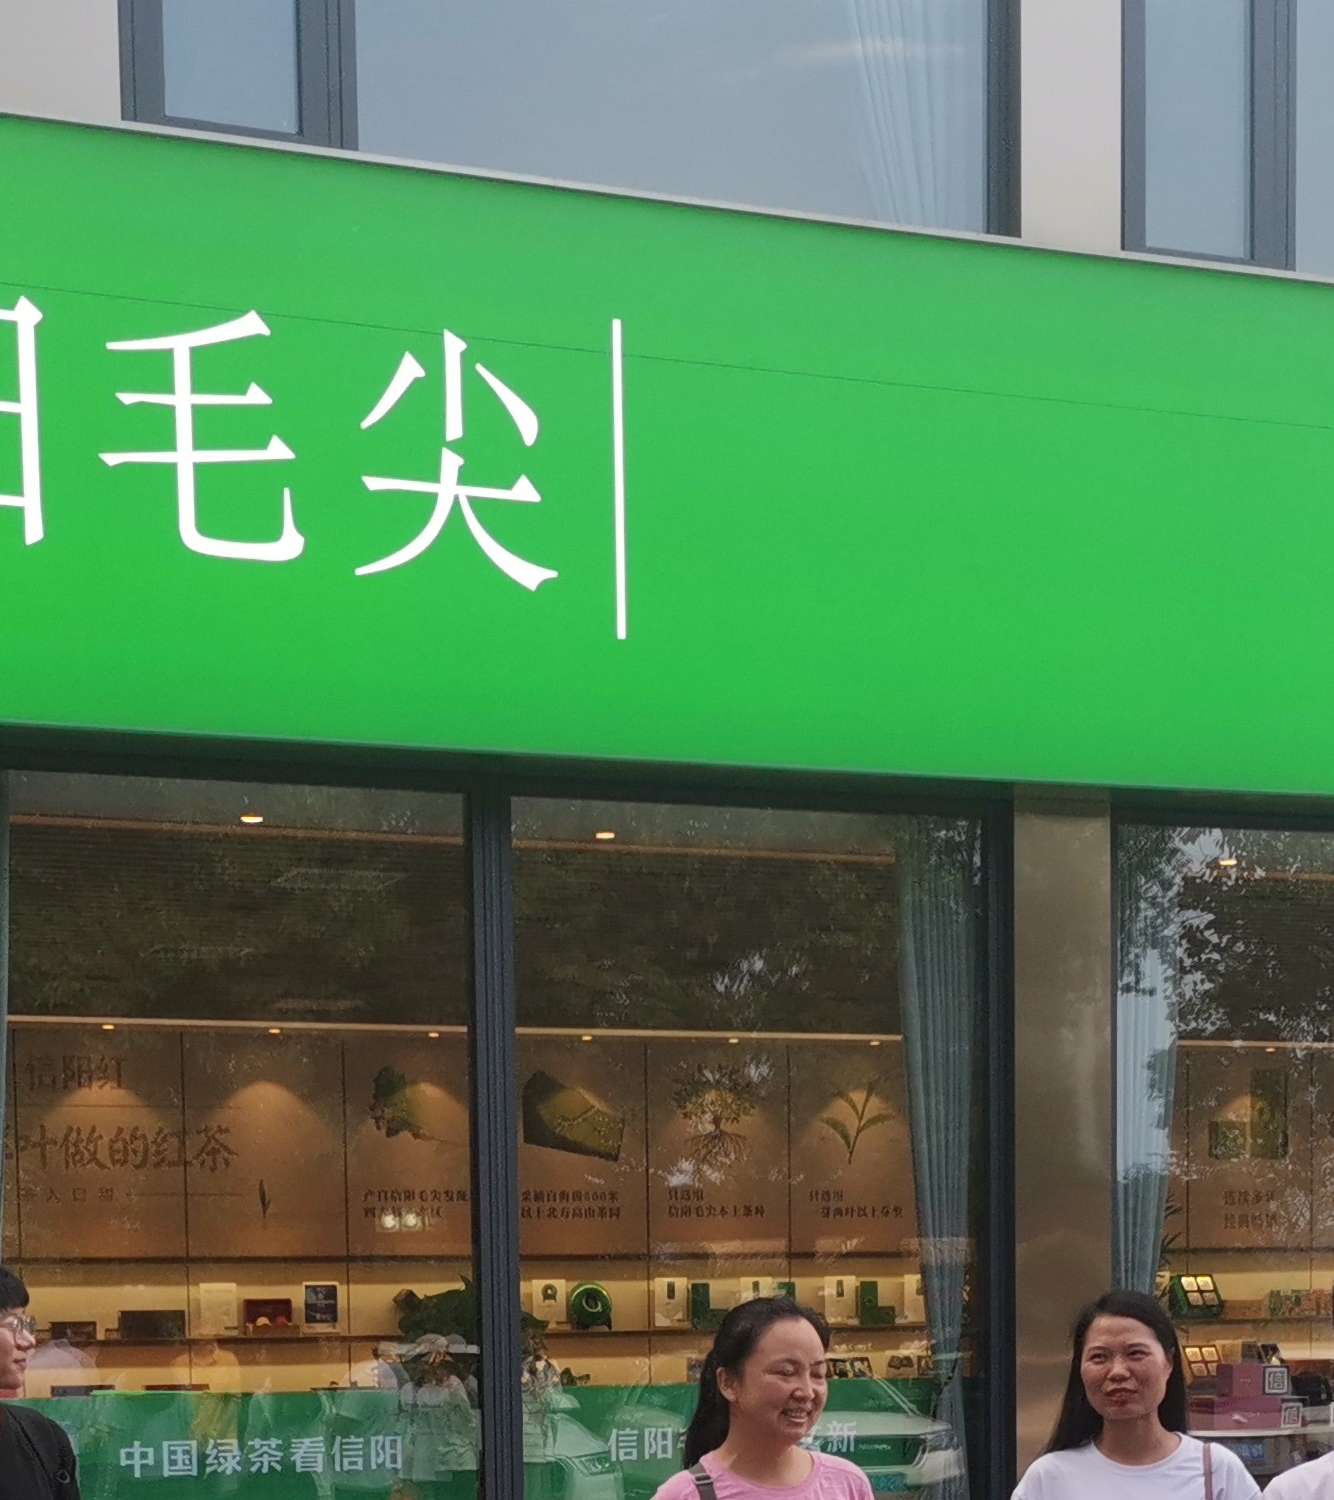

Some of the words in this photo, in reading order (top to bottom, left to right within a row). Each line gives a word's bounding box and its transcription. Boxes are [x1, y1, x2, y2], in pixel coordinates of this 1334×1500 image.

[24, 1053, 129, 1091] 信阳红
[119, 1434, 404, 1478] 中国绿茶看信阳
